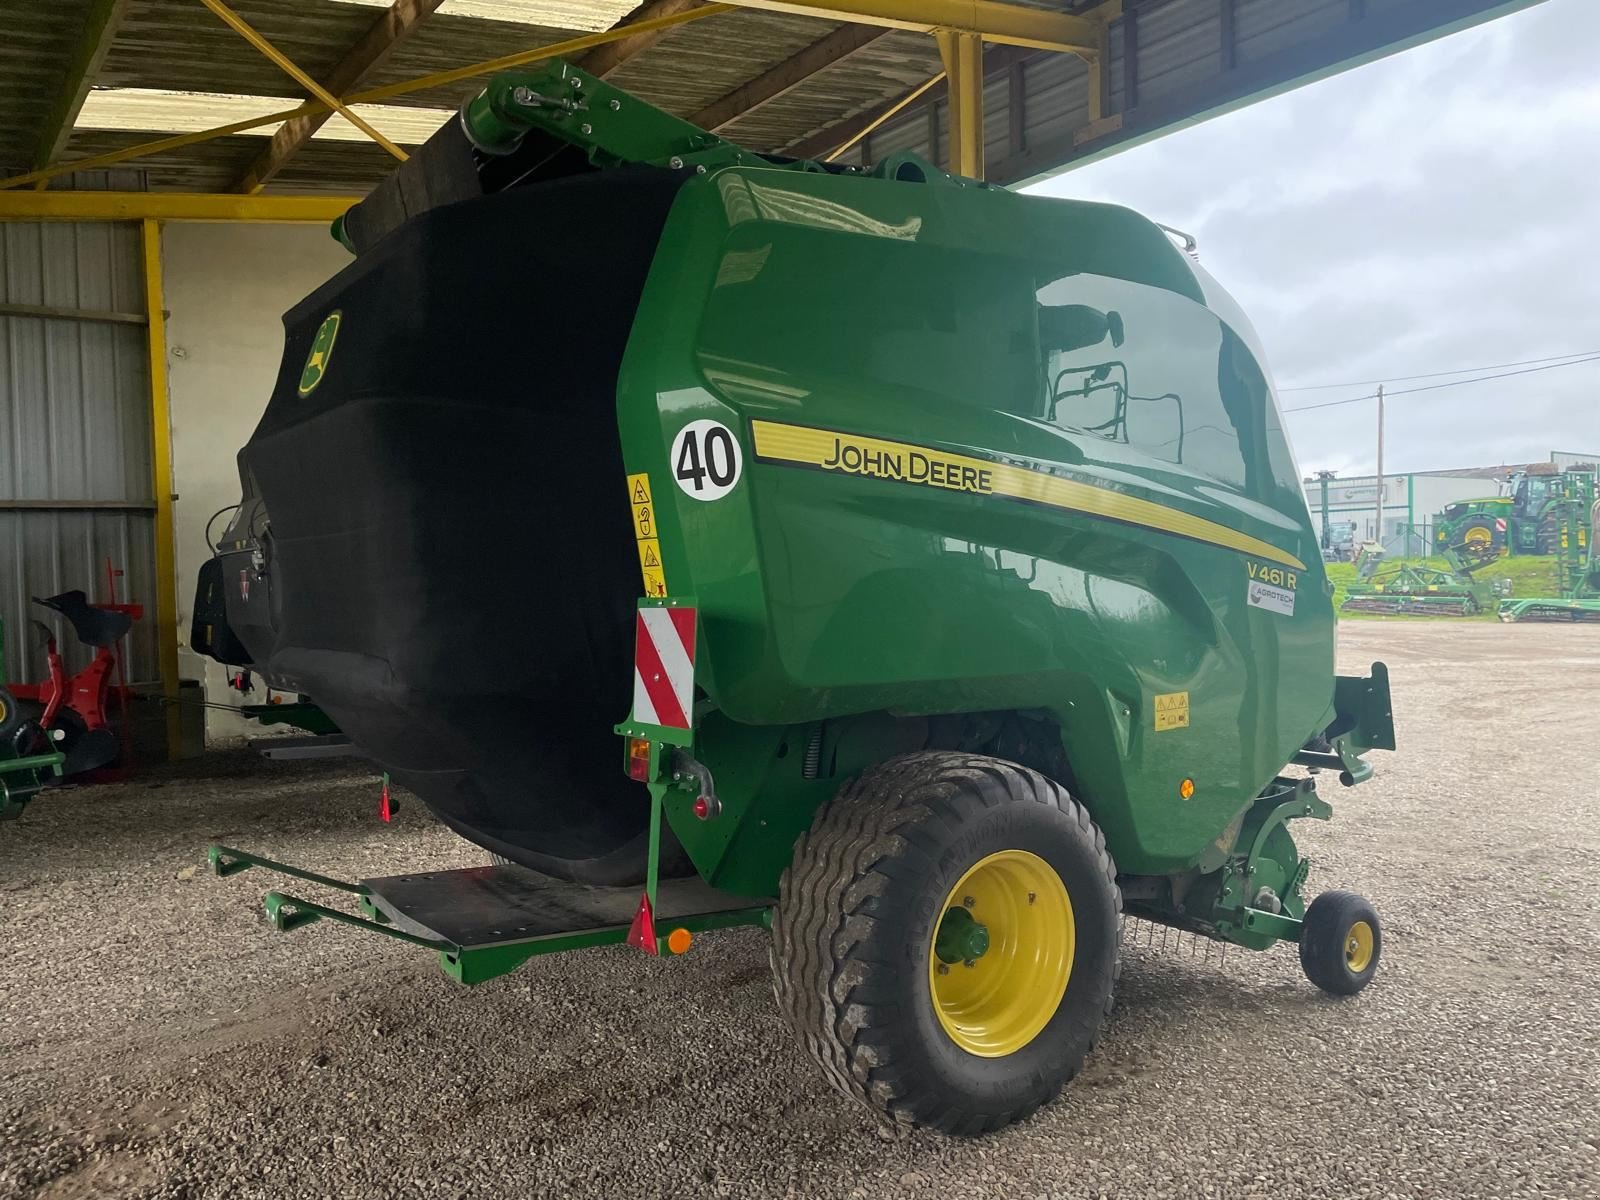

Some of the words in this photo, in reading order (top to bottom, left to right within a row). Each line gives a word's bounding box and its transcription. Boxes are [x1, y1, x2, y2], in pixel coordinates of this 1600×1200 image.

[676, 426, 736, 491] 40
[824, 438, 902, 477] JOHN
[909, 452, 993, 492] DEERE
[1247, 561, 1258, 578] V
[1259, 566, 1285, 587] 461
[1287, 572, 1297, 590] R
[1256, 587, 1294, 604] AGROTECH
